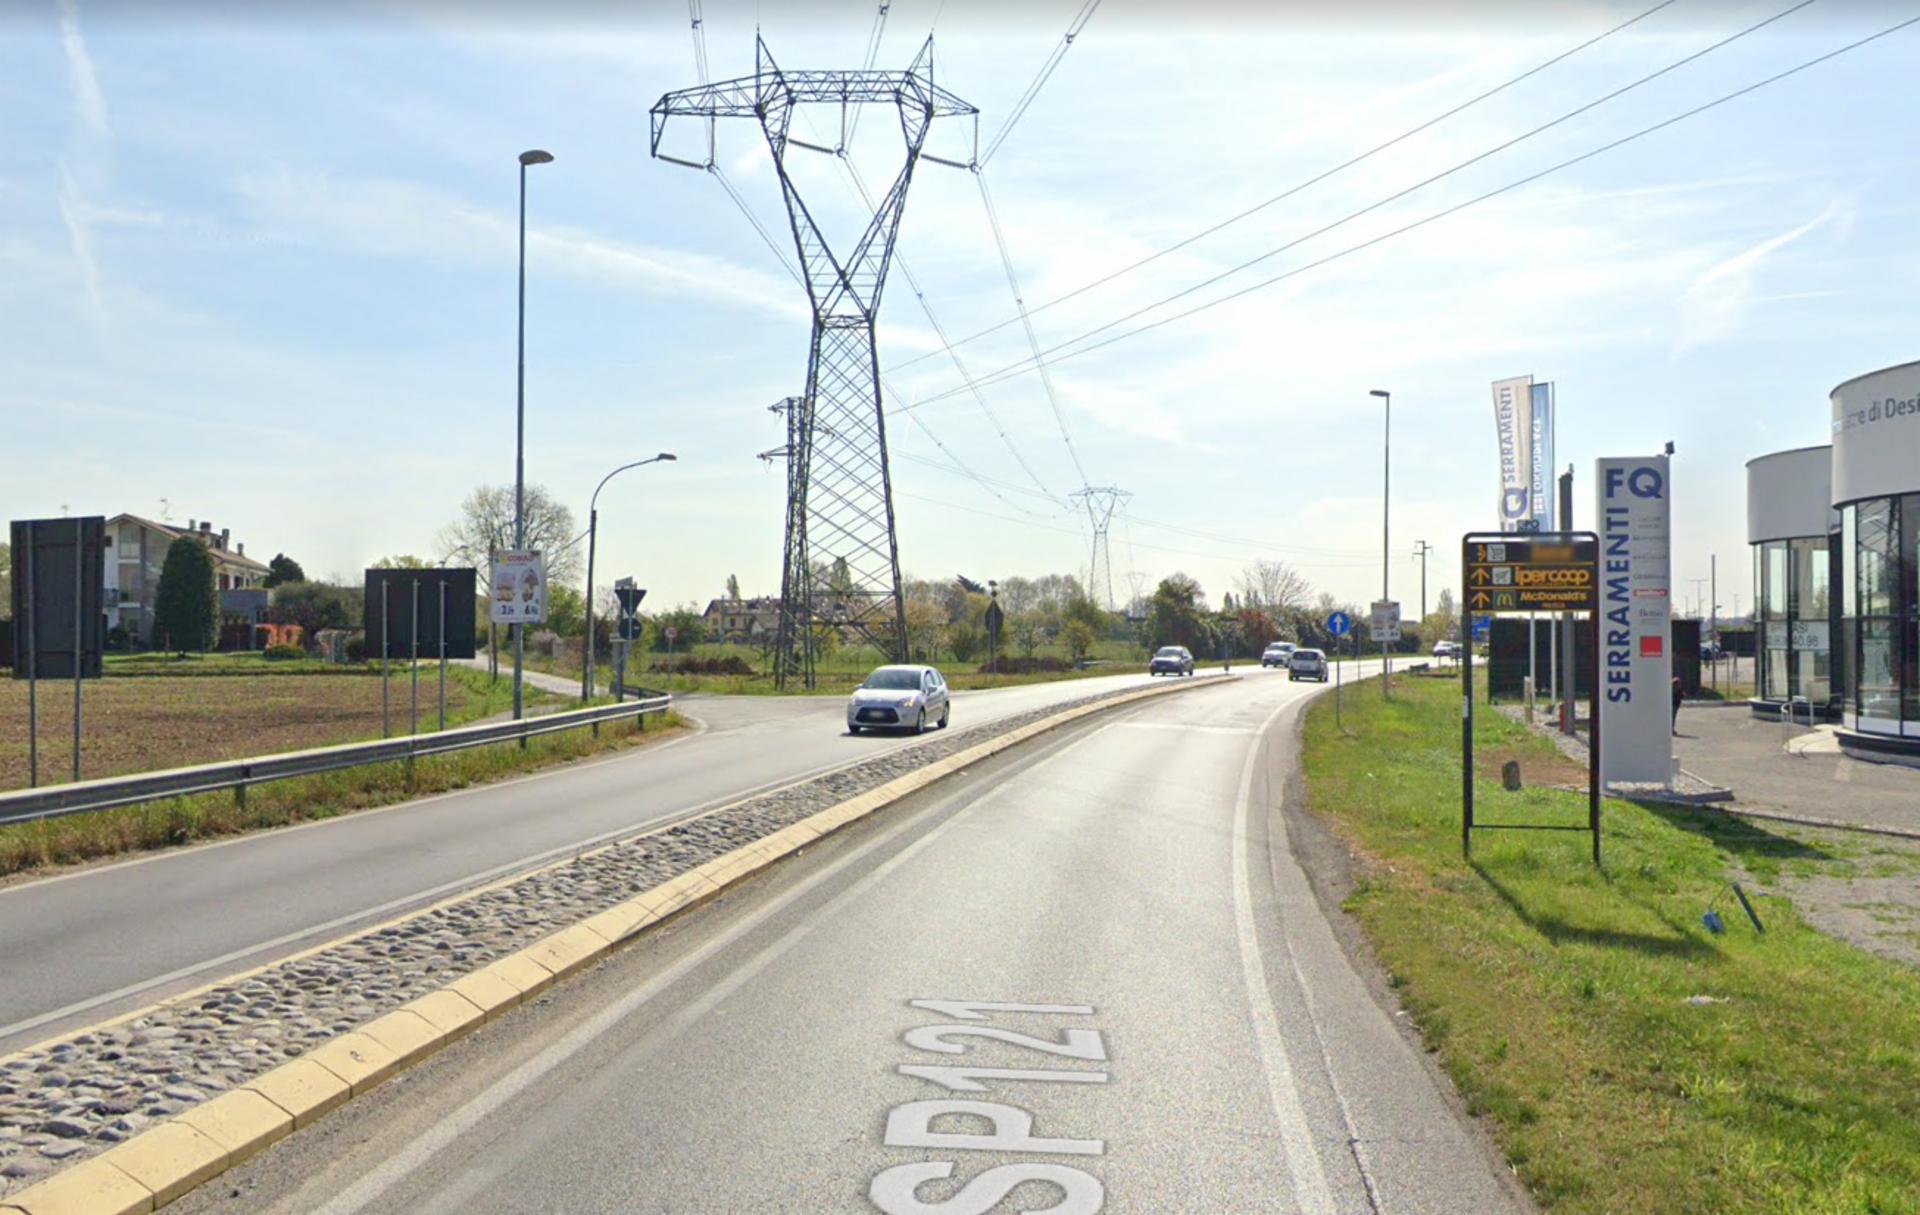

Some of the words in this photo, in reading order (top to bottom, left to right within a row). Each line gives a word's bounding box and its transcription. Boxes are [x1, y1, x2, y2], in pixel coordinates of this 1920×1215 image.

[1500, 386, 1516, 482] SERRAMENTI
[1606, 467, 1663, 499] FQ
[1515, 566, 1590, 585] ipercoop
[1521, 592, 1587, 602] McDonald's
[1606, 508, 1630, 702] SERRAMENTI
[868, 998, 1109, 1215] SP121
